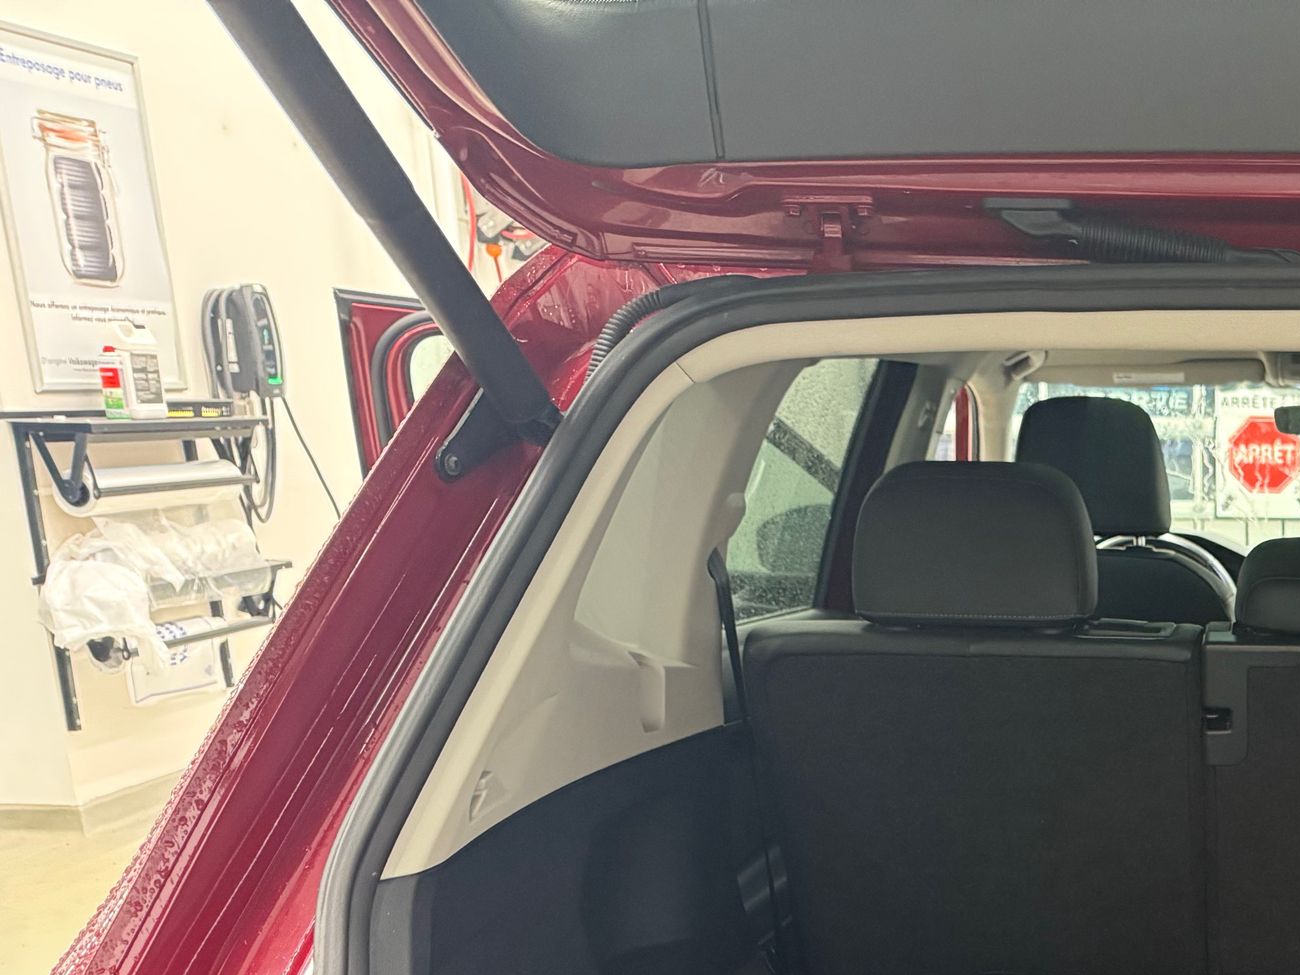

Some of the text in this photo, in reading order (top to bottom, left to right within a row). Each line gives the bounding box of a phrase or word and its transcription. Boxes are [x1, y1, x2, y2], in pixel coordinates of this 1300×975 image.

[0, 47, 123, 92] Entreposage pour pneus
[1234, 438, 1295, 465] ARRÊT
